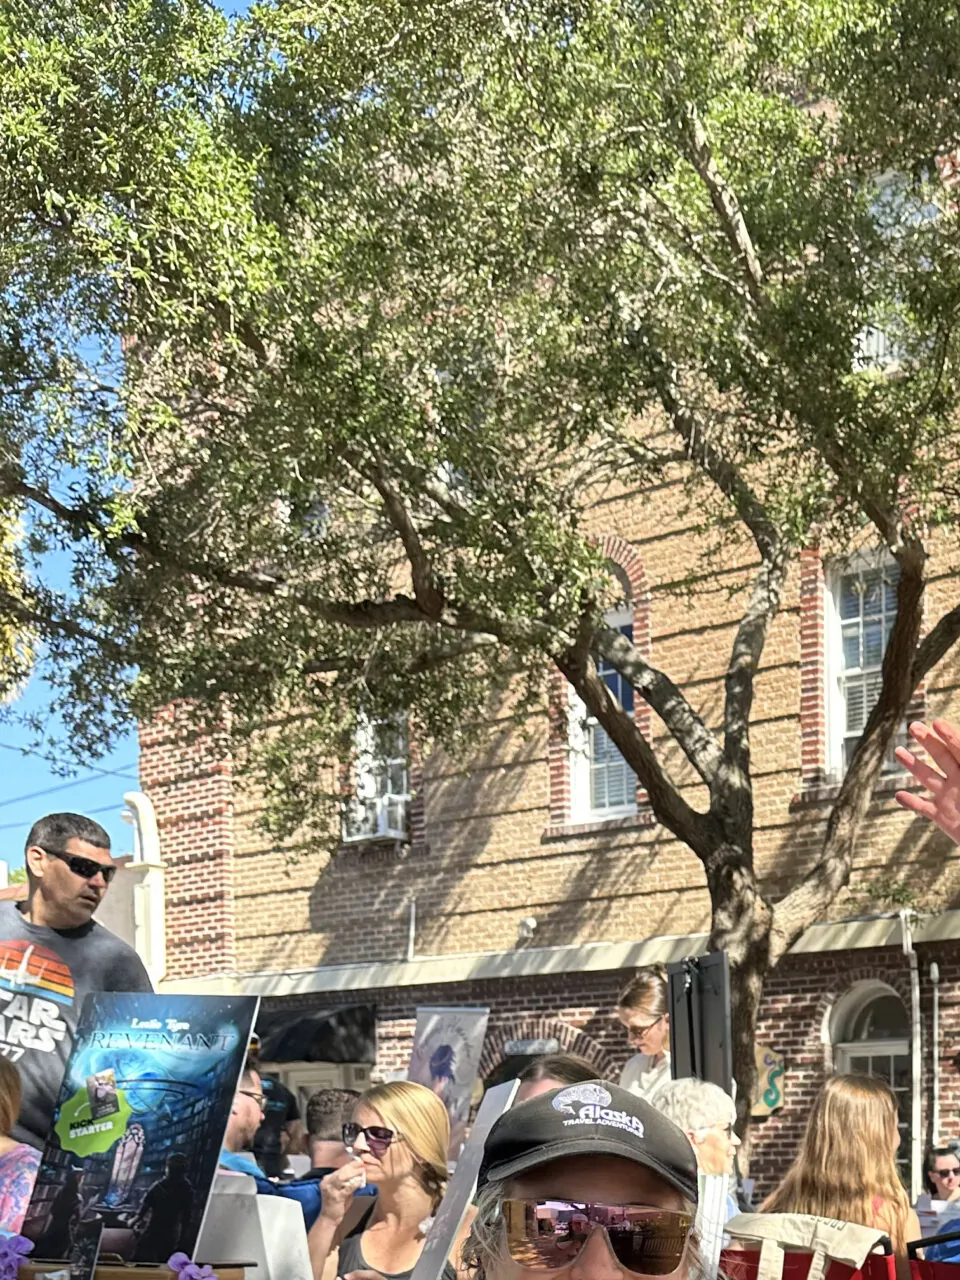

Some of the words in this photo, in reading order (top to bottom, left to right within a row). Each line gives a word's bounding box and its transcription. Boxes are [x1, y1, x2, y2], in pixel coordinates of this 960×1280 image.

[0, 988, 67, 1032] AR
[89, 1030, 236, 1051] REVENANT
[69, 1118, 95, 1130] KICK
[69, 1121, 114, 1139] STARTER
[562, 1117, 595, 1127] TRAVEL
